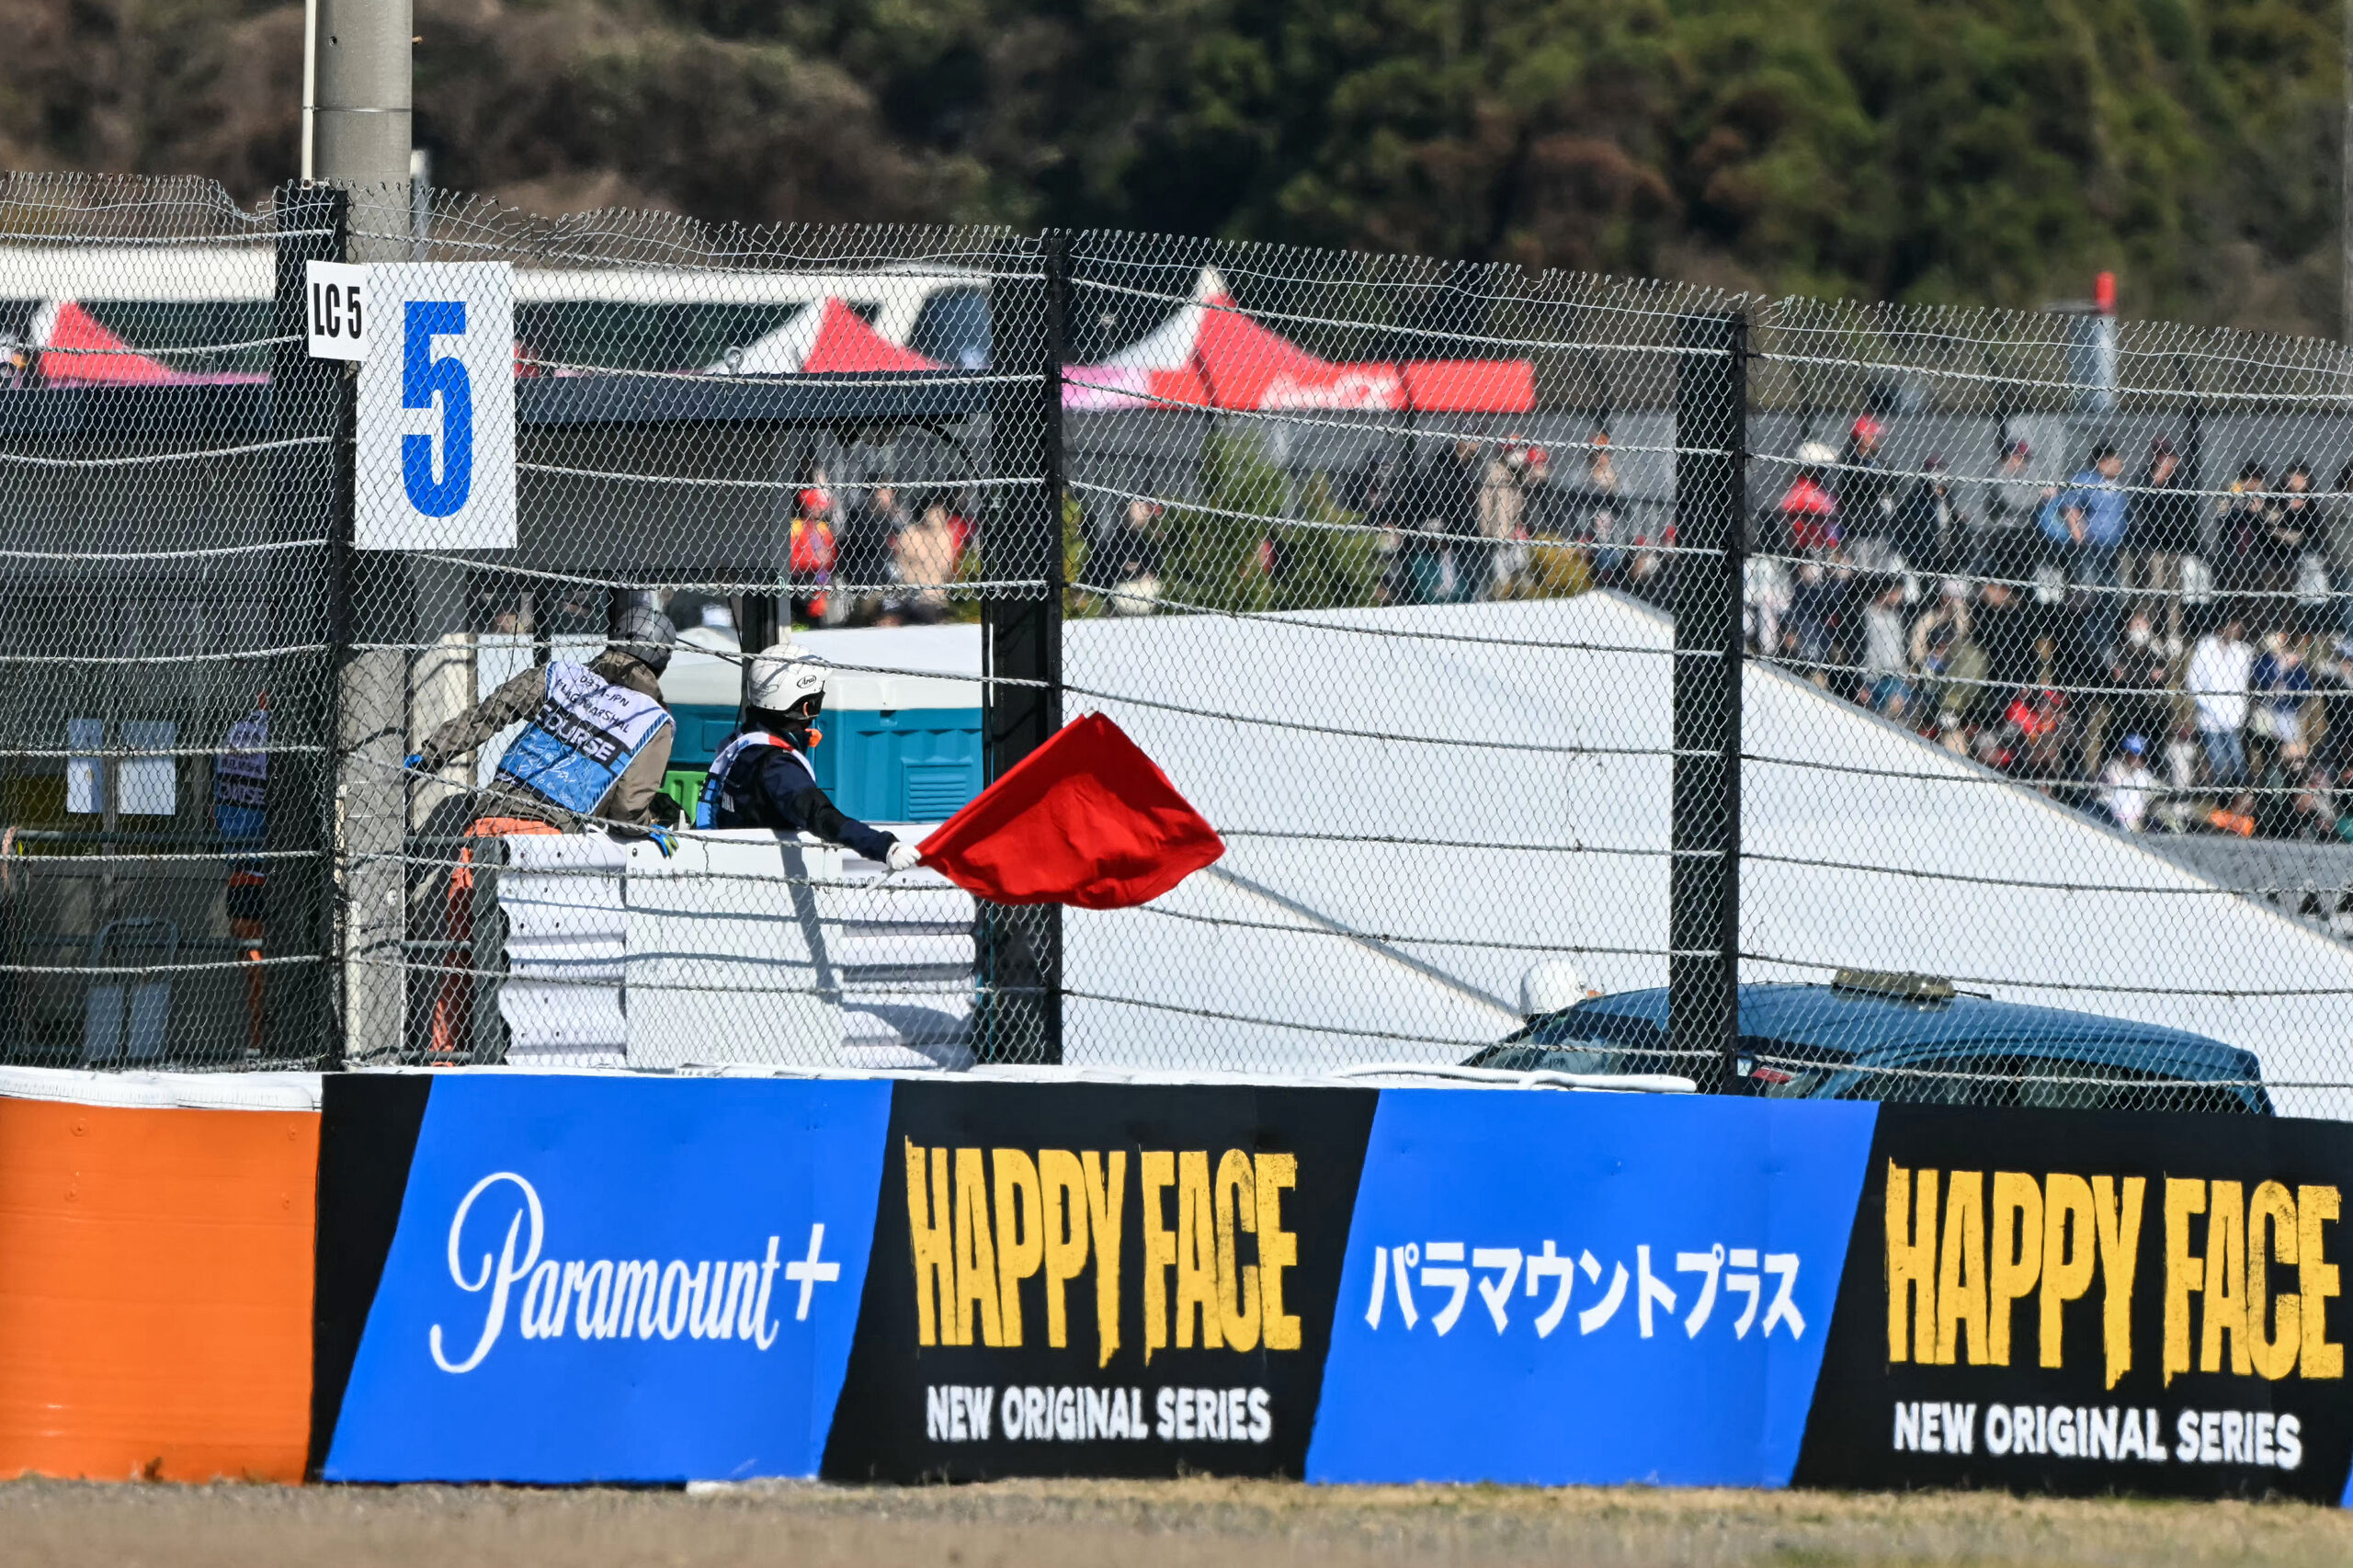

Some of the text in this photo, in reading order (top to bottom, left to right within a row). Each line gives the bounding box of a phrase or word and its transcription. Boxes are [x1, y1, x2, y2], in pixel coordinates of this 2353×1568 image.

[313, 283, 362, 339] LC 5
[403, 301, 472, 517] 5
[555, 678, 630, 733] FLAG MARSHAL
[798, 676, 816, 687] Arai
[535, 703, 617, 762] COURSE
[430, 1172, 840, 1374] Paramount+
[904, 1136, 1302, 1369] HAPPY FACE
[1885, 1157, 2345, 1390] HAPPY FACE
[1365, 1239, 1807, 1341] パラマウントプラス
[926, 1384, 1272, 1443] NEW ORIGINAL SERIES
[1893, 1401, 2303, 1471] NEW ORIGINAL SERIES
